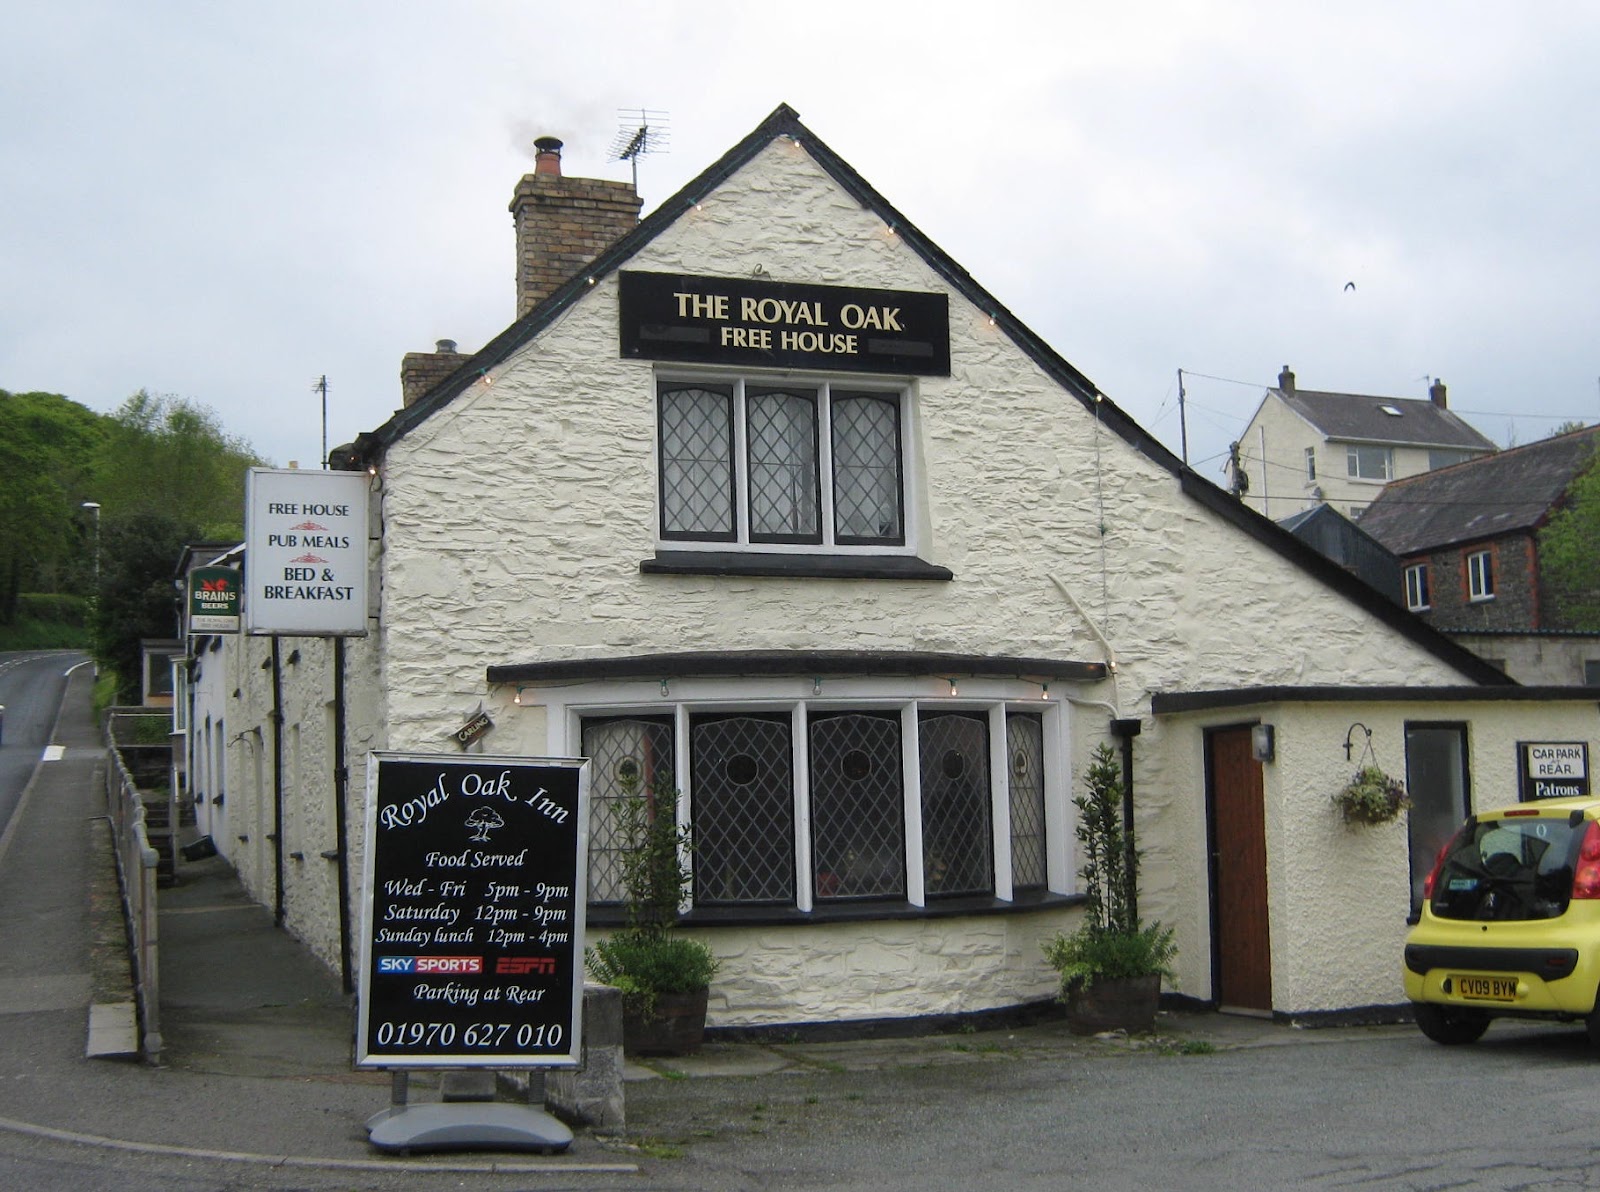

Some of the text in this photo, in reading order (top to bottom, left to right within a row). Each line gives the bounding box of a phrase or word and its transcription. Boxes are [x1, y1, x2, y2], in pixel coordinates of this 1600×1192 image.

[673, 292, 902, 331] THE ROYAL OAK
[721, 326, 858, 354] FREE HOUSE
[269, 503, 349, 516] FREE HOUSE
[268, 535, 349, 548] PUB MEALS
[284, 567, 334, 581] BED &
[194, 591, 236, 600] BRAINS
[264, 586, 354, 600] BREAKFAST
[1532, 748, 1581, 759] CAR PARK
[1536, 781, 1580, 797] Patrons
[380, 770, 569, 830] Royal Oak Inn
[425, 849, 529, 868] Food Served
[384, 878, 427, 897] Wed
[440, 879, 467, 897] Fri
[484, 881, 520, 902] 5pm
[536, 882, 569, 902] 9pm
[384, 902, 460, 924] Saturday
[475, 906, 517, 925] 12pm
[533, 906, 567, 926] 9pm
[375, 927, 431, 947] Sunday
[434, 929, 474, 944] lunch
[487, 929, 524, 946] 12pm
[538, 930, 568, 947] 4pm
[380, 958, 480, 972] SKY SPORTS
[496, 958, 555, 974] ESPN
[413, 983, 545, 1006] Parking at Rear
[1460, 979, 1517, 996] CV09 BYM
[377, 1022, 563, 1047] 01970 627 010
